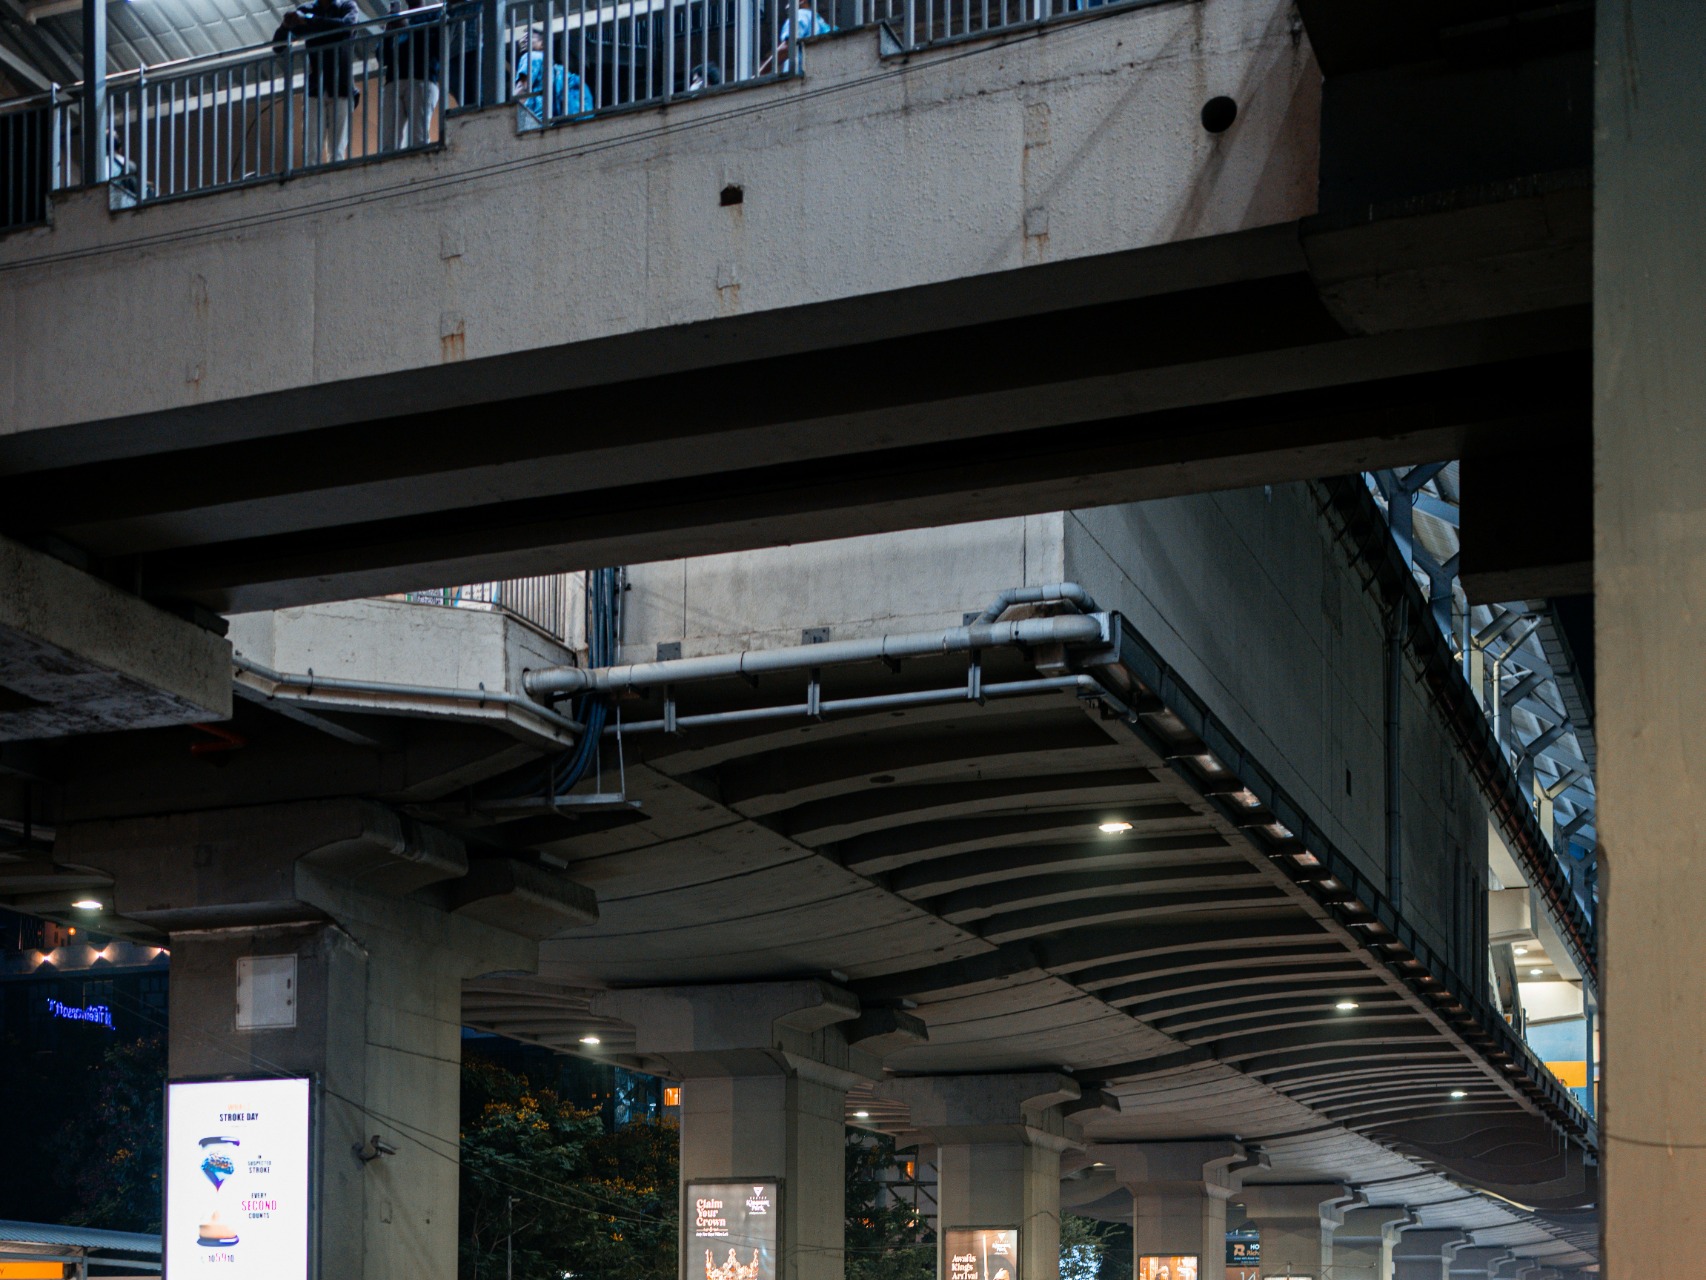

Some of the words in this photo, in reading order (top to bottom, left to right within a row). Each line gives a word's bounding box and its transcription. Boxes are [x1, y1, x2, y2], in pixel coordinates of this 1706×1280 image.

[219, 1113, 244, 1122] STROKE
[246, 1113, 259, 1121] DAY
[241, 1200, 277, 1211] SECOND
[696, 1199, 723, 1209] Claim
[696, 1208, 719, 1218] Your
[696, 1217, 726, 1227] Crown
[952, 1253, 977, 1262] Awaits
